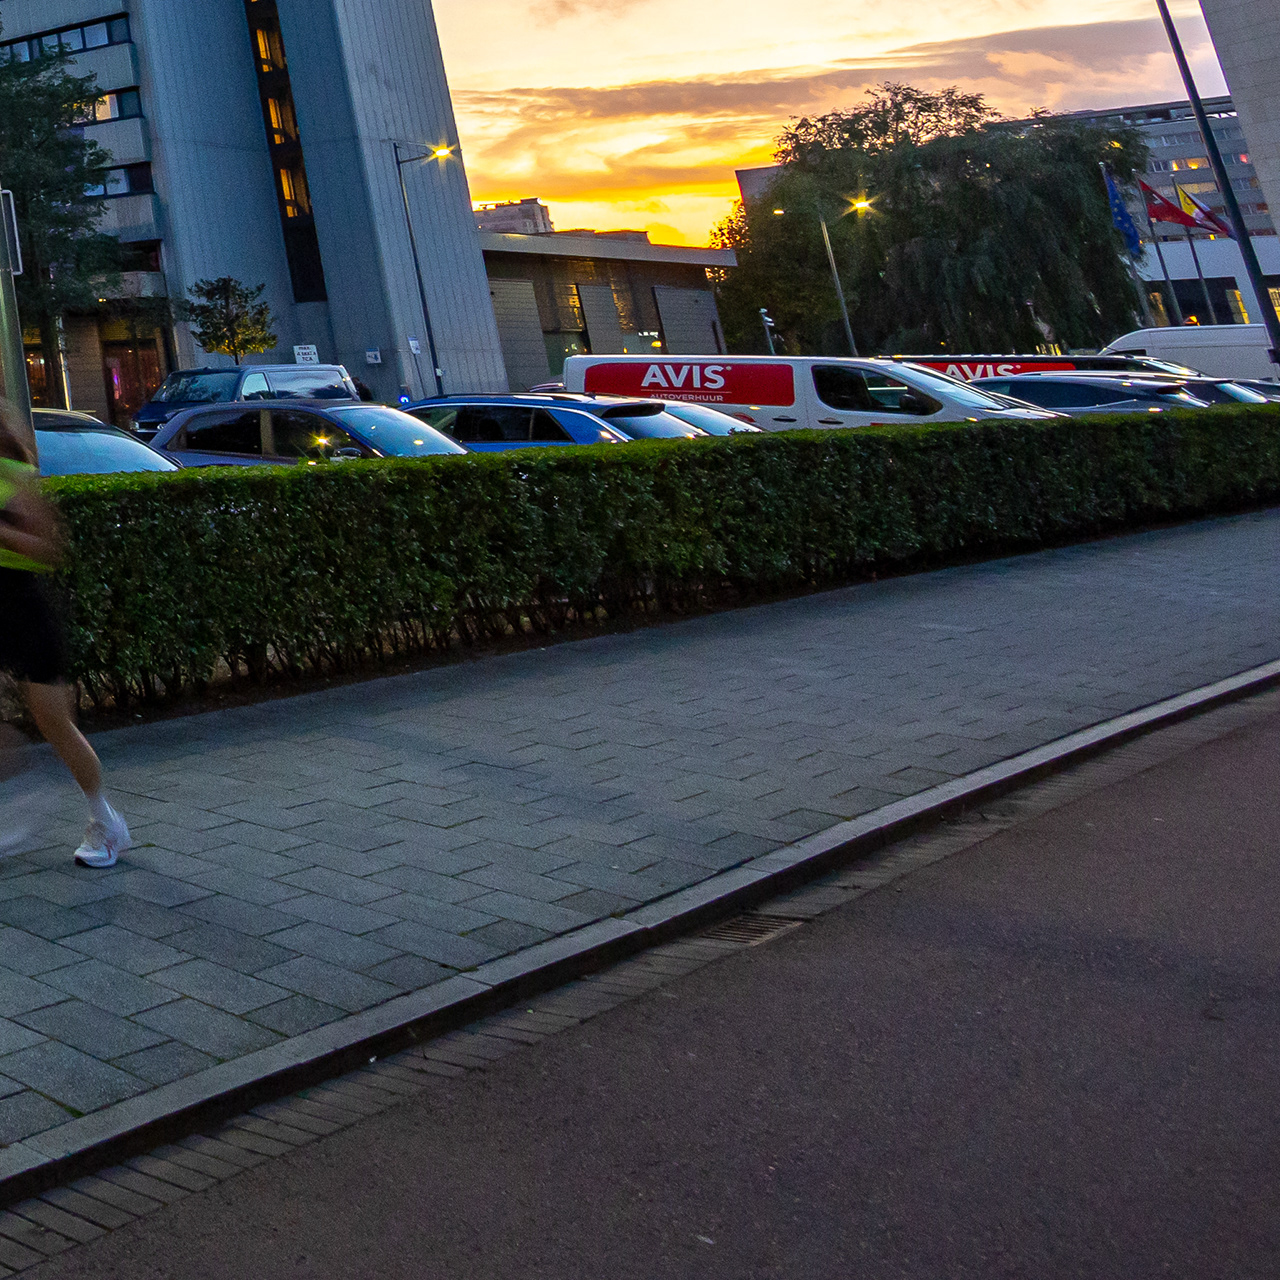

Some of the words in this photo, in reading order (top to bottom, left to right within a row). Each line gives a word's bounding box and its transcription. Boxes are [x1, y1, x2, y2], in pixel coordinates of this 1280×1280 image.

[641, 364, 725, 390] AVIS
[946, 364, 1014, 381] AVIS
[650, 393, 724, 401] AUTOVERHUUR
